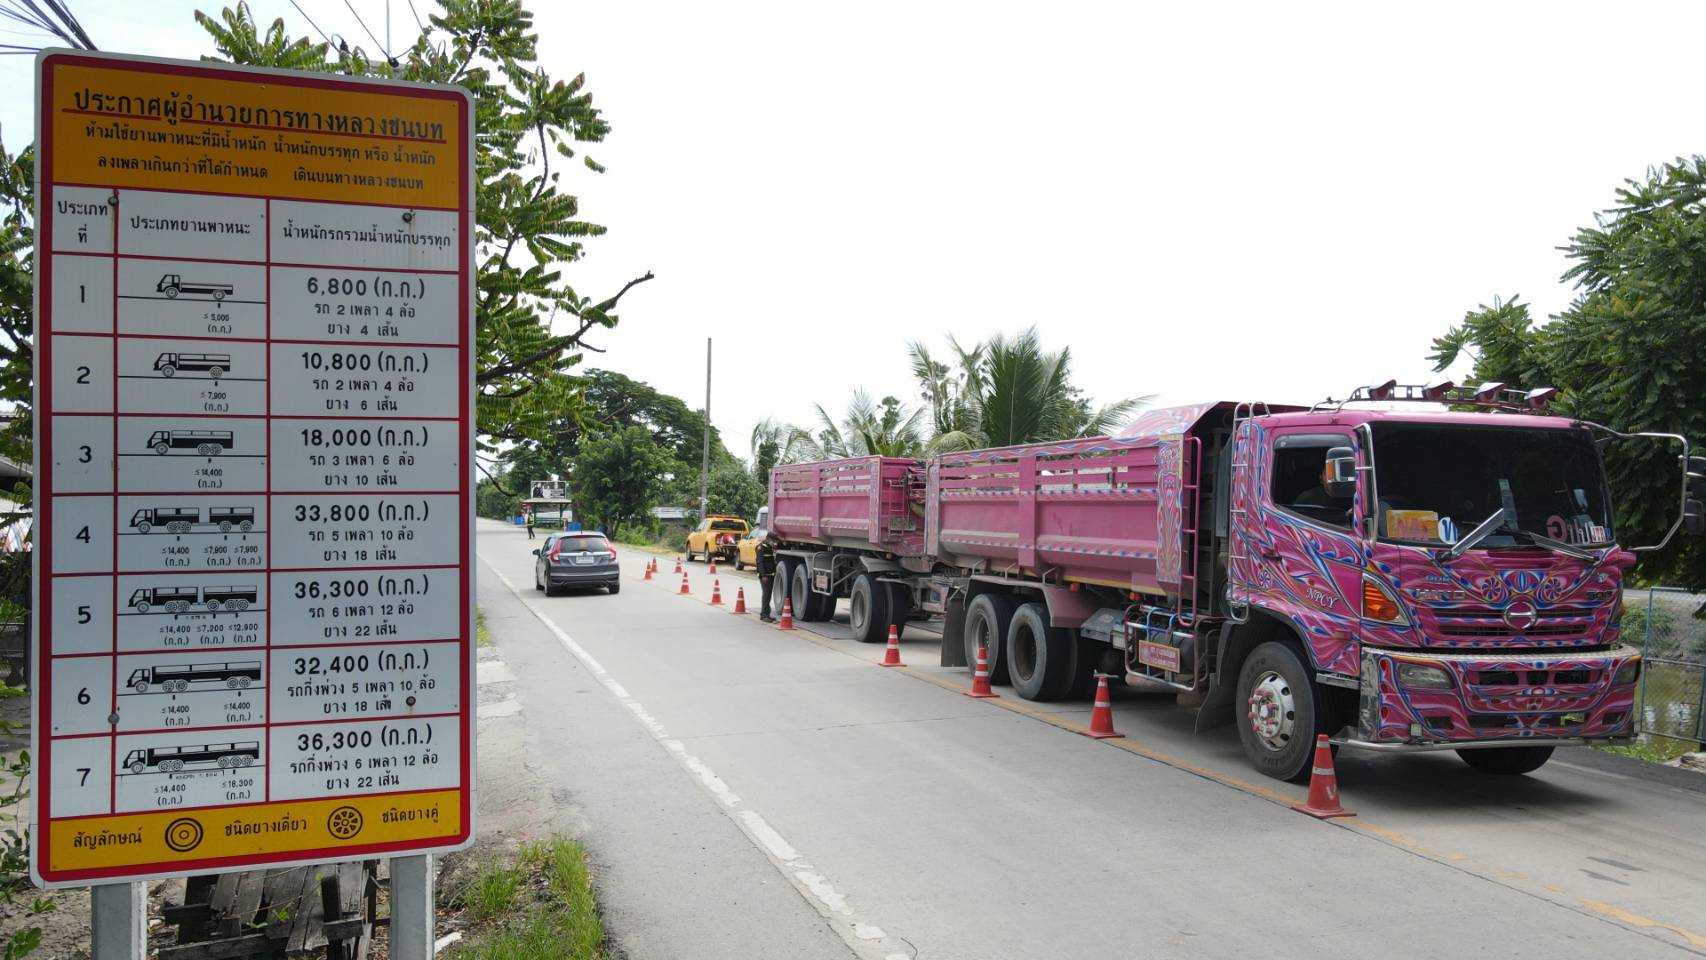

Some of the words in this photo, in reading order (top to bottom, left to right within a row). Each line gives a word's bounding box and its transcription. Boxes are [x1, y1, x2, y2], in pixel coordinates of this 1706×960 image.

[74, 87, 444, 139] ประกาศผู้อำนวยการทางหลวงชนบท
[85, 119, 269, 152] ห้ามใช้ยานพาหนะที่มีน้ำหนัก
[273, 133, 360, 163] น้ำหนักบรรทุก
[363, 145, 390, 162] หรือ
[393, 144, 436, 166] น้ำหนัก
[98, 154, 268, 179] ลงเพลาเกินกว่าที่ได้กำหนด
[293, 166, 424, 190] เดินบนทางหลวงชนบท
[57, 200, 108, 216] ประเภท
[77, 225, 88, 244] ที่
[130, 215, 251, 235] ประเภทยานพาหนะ
[282, 216, 451, 251] น้ำหนักรถรวมน้ำหนักบรรทุก
[80, 285, 84, 303] 1
[307, 276, 367, 297] 6,800
[373, 276, 425, 300] (ก.ก.)
[314, 303, 330, 315] รถ
[336, 304, 346, 316] 2
[350, 304, 379, 317] เพลา
[385, 306, 394, 318] 4
[399, 302, 416, 319] ล้อ
[327, 323, 351, 335] ยาง
[360, 324, 369, 336] 4
[377, 320, 399, 337] เส้น
[301, 351, 371, 372] 10,800
[377, 350, 429, 374] (ก.ก.)
[76, 365, 91, 385] 2
[312, 379, 329, 390] รถ
[335, 379, 344, 391] 2
[348, 379, 378, 391] เพลา
[383, 380, 392, 392] 4
[398, 376, 414, 393] ล้อ
[326, 399, 349, 410] ยาง
[361, 400, 367, 410] 6
[376, 395, 398, 411] เส้น
[301, 428, 372, 449] 18,000
[377, 425, 429, 448] (ก.ก.)
[78, 445, 93, 464] 3
[309, 455, 326, 466] รถ
[333, 456, 339, 466] 3
[345, 455, 375, 466] เพลา
[383, 455, 389, 465] 6
[398, 450, 415, 466] ล้อ
[324, 474, 348, 486] ยาง
[355, 474, 369, 486] 10
[376, 469, 398, 486] เส้น
[295, 504, 370, 524] 33,800
[377, 500, 429, 522] (ก.ก.)
[75, 525, 91, 544] 4
[308, 530, 325, 542] รถ
[331, 530, 340, 542] 5
[344, 530, 374, 542] เพลา
[380, 529, 394, 541] 10
[397, 524, 414, 541] ล้อ
[323, 550, 347, 562] ยาง
[354, 550, 368, 561] 18
[375, 544, 397, 561] เส้น
[294, 579, 369, 601] 36,300
[377, 573, 429, 597] (ก.ก.)
[1306, 587, 1340, 609] NPCY
[77, 605, 92, 625] 5
[308, 607, 325, 619] รถ
[331, 606, 340, 618] 6
[344, 605, 374, 617] เพลา
[380, 604, 394, 616] 12
[398, 599, 414, 615] ล้อ
[323, 626, 347, 639] ยาง
[354, 625, 371, 637] 22
[375, 619, 398, 636] เส้น
[294, 654, 369, 676] 32,400
[377, 648, 429, 672] (ก.ก.)
[287, 676, 345, 697] รถกิ่งพ่วง
[352, 683, 358, 693] 5
[365, 681, 395, 694] เพลา
[400, 680, 413, 692] 10
[419, 673, 436, 690] ล้อ
[77, 687, 92, 706] 6
[323, 701, 347, 714] ยาง
[354, 700, 368, 713] 18
[297, 730, 372, 753] 36,300
[380, 722, 433, 747] (ก.ก.)
[289, 753, 348, 774] รถกิ่งพ่วง
[355, 759, 361, 769] 6
[368, 756, 397, 769] เพลา
[403, 754, 416, 767] 12
[422, 749, 438, 765] ล้อ
[76, 767, 91, 787] 7
[326, 777, 350, 791] ยาง
[357, 776, 373, 789] 22
[378, 769, 400, 787] เส้น
[381, 802, 439, 824] ชนิดยางคู่
[224, 811, 307, 837] ชนิดยางเดี่ยว
[73, 826, 143, 850] สัญลักษณ์
